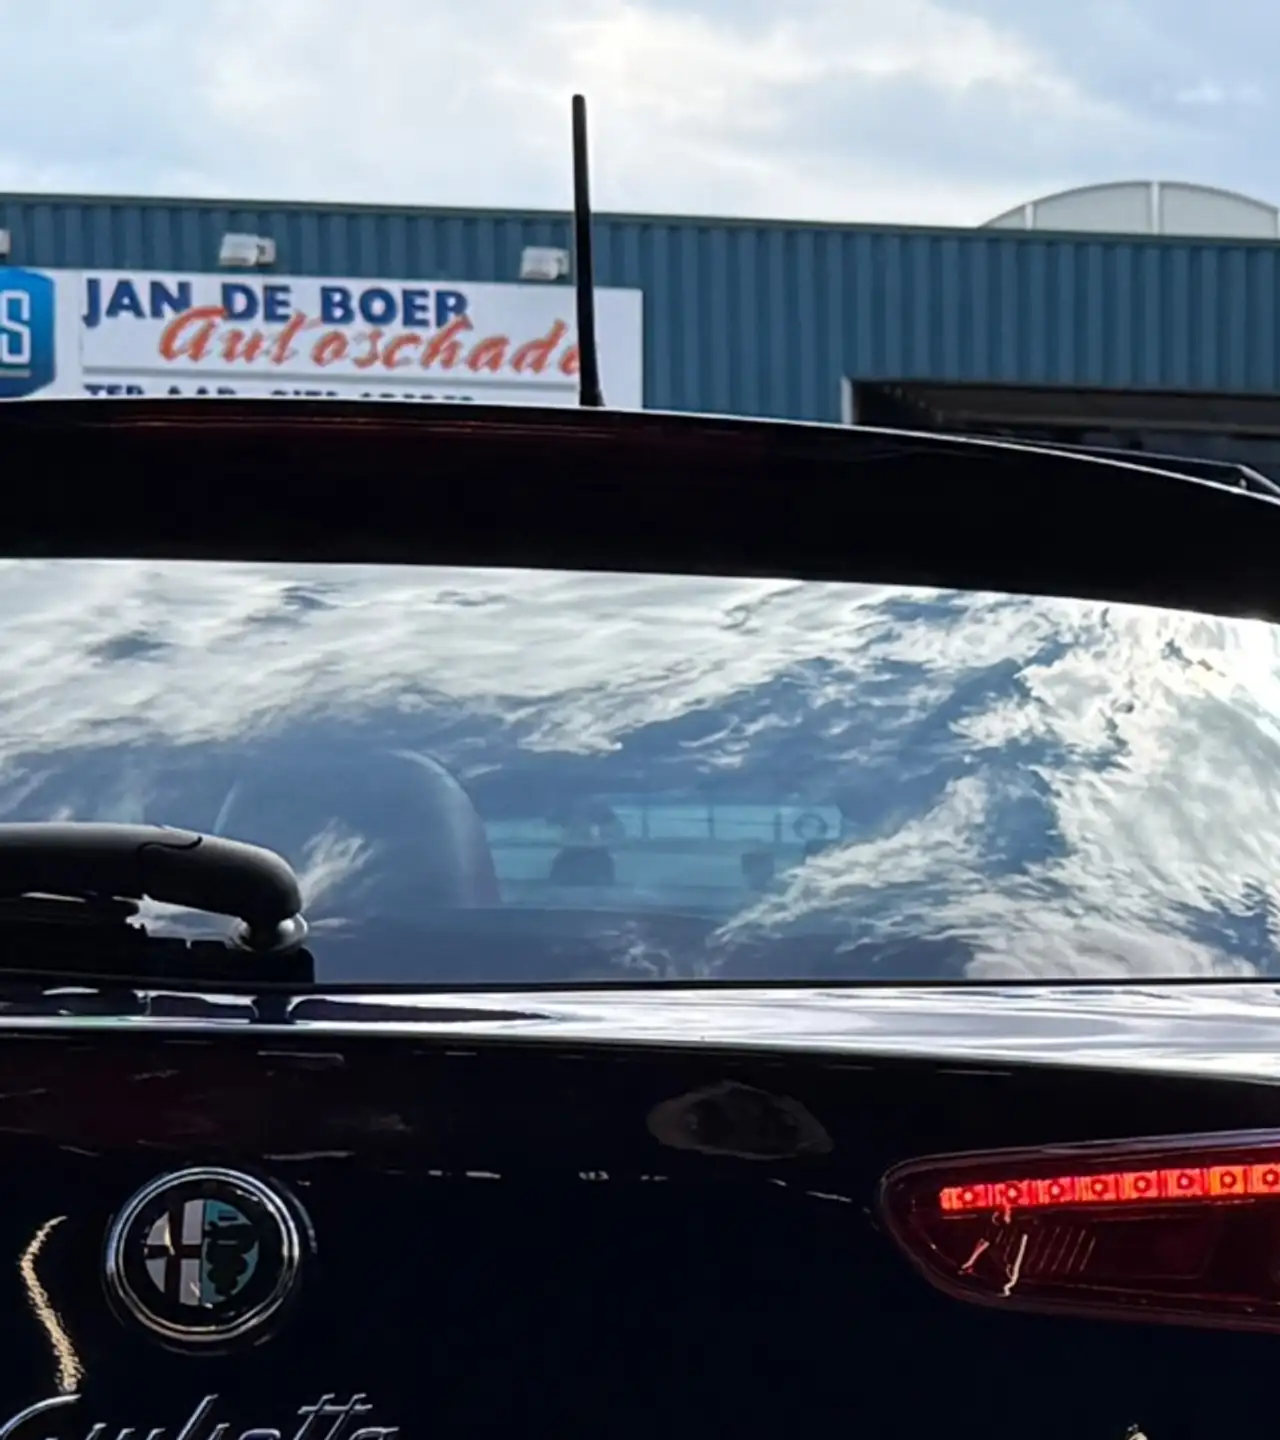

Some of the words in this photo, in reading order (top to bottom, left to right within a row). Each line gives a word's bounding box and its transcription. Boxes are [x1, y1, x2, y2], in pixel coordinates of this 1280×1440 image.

[82, 278, 193, 329] JAN
[221, 282, 290, 323] DE
[320, 286, 471, 330] BOER
